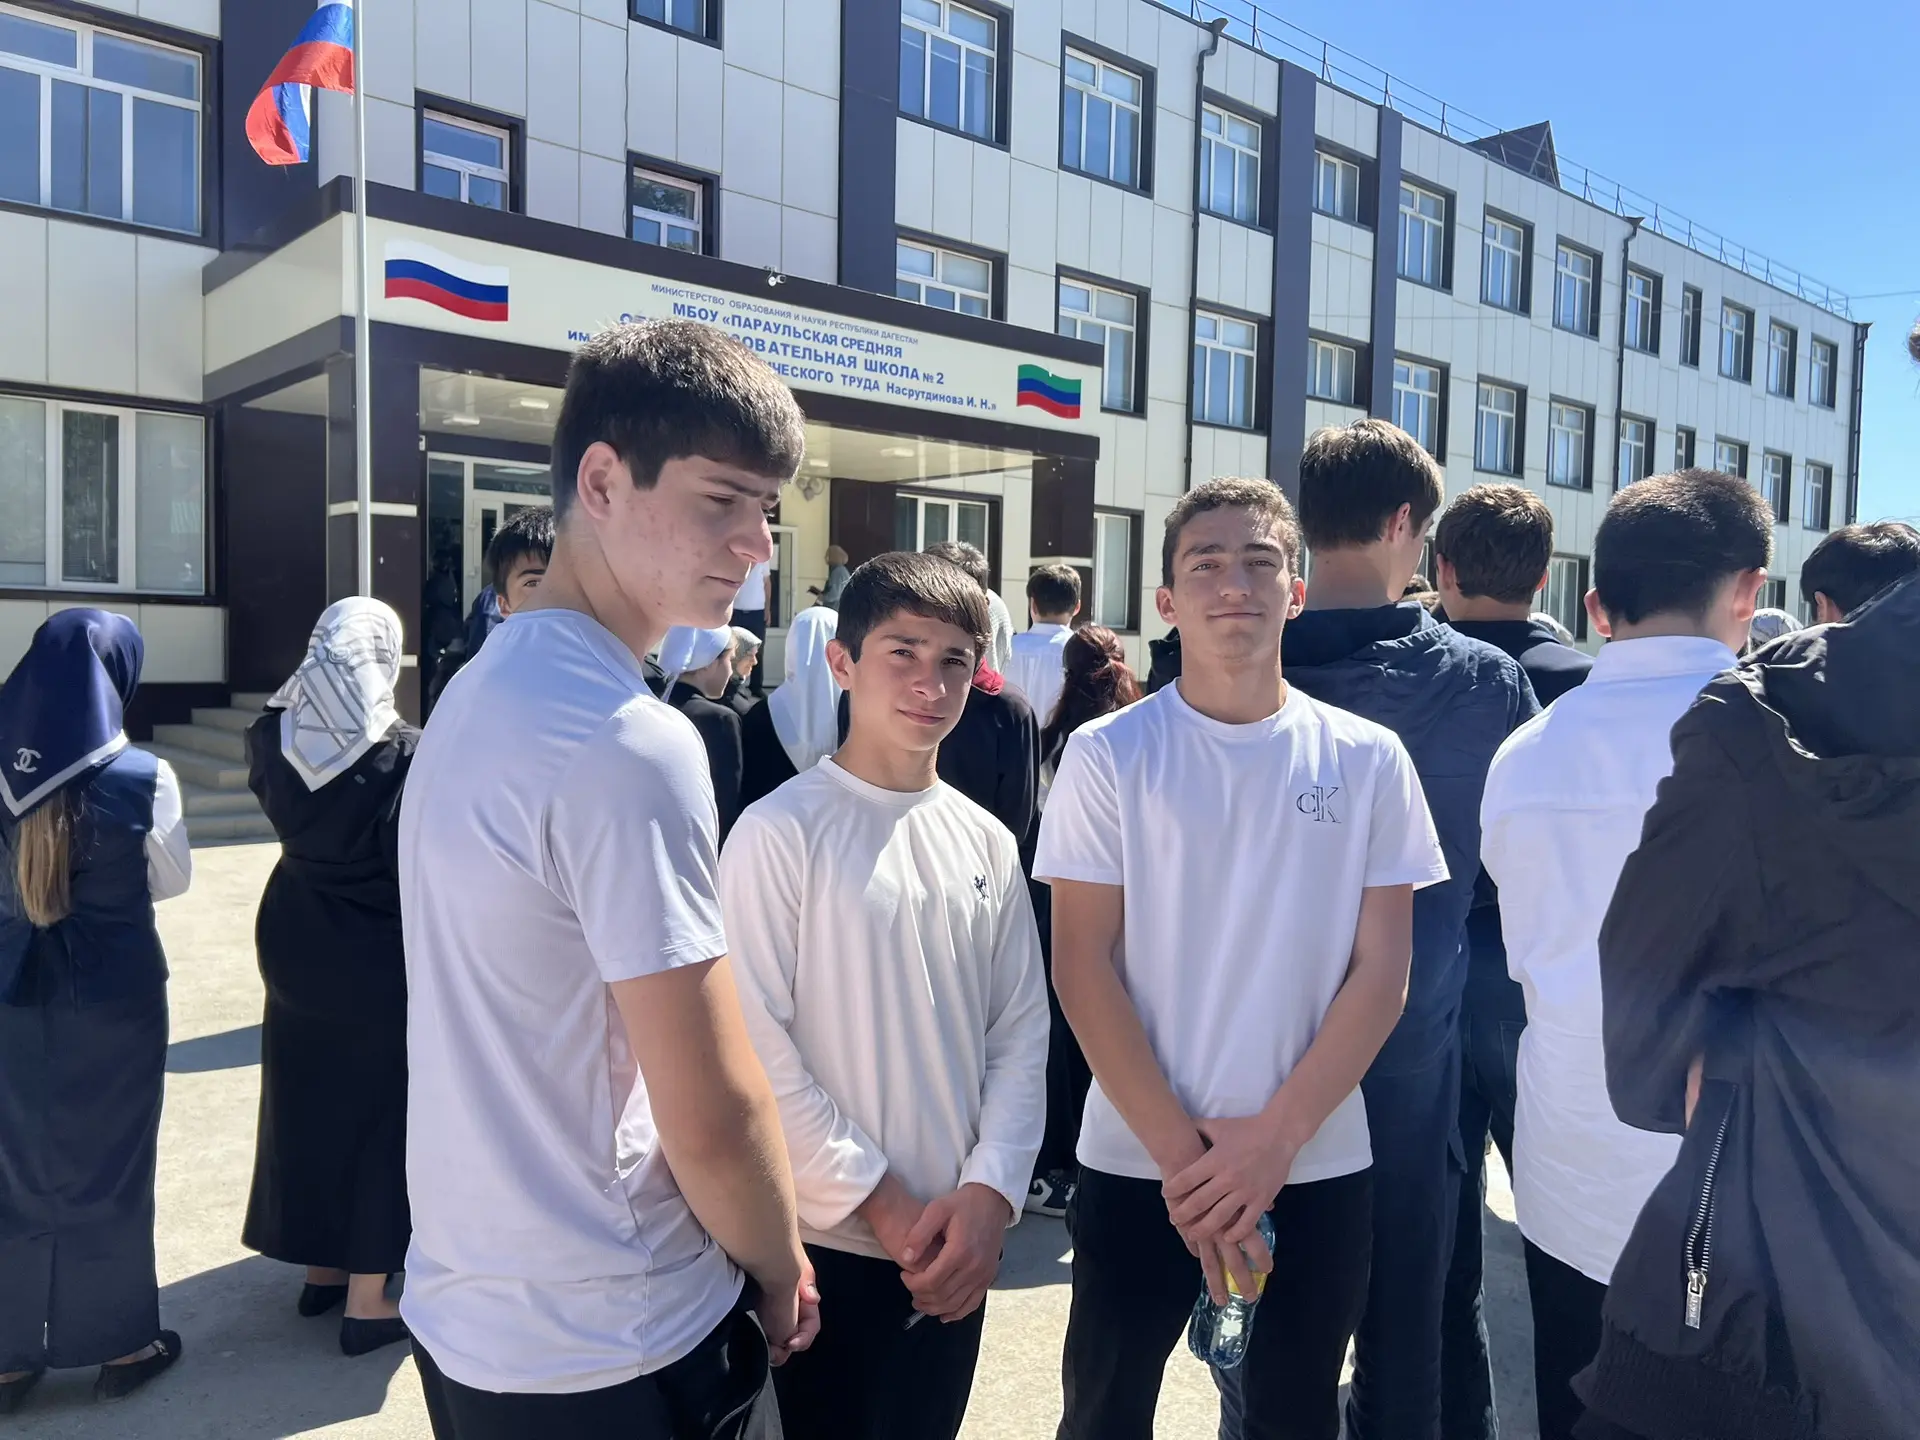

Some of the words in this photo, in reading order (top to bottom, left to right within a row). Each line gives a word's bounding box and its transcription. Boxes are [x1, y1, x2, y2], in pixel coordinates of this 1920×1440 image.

[651, 284, 725, 305] МИНИСТЕРСТВО
[729, 300, 792, 320] ОБРАЗОВАНИЯ
[794, 312, 801, 321] И
[801, 314, 828, 327] НАУКИ
[829, 320, 880, 337] РЕСПУБЛИКИ
[881, 331, 919, 345] ДАГЕСТАН
[672, 302, 719, 323] МБОУ
[722, 314, 839, 347] «ПАРАУЛЬСКАЯ
[840, 338, 903, 360] СРЕДНЯЯ
[841, 373, 880, 393] ТРУДА
[886, 381, 964, 407] Насрутдинова
[864, 360, 920, 382] ШКОЛА
[936, 372, 945, 385] 2
